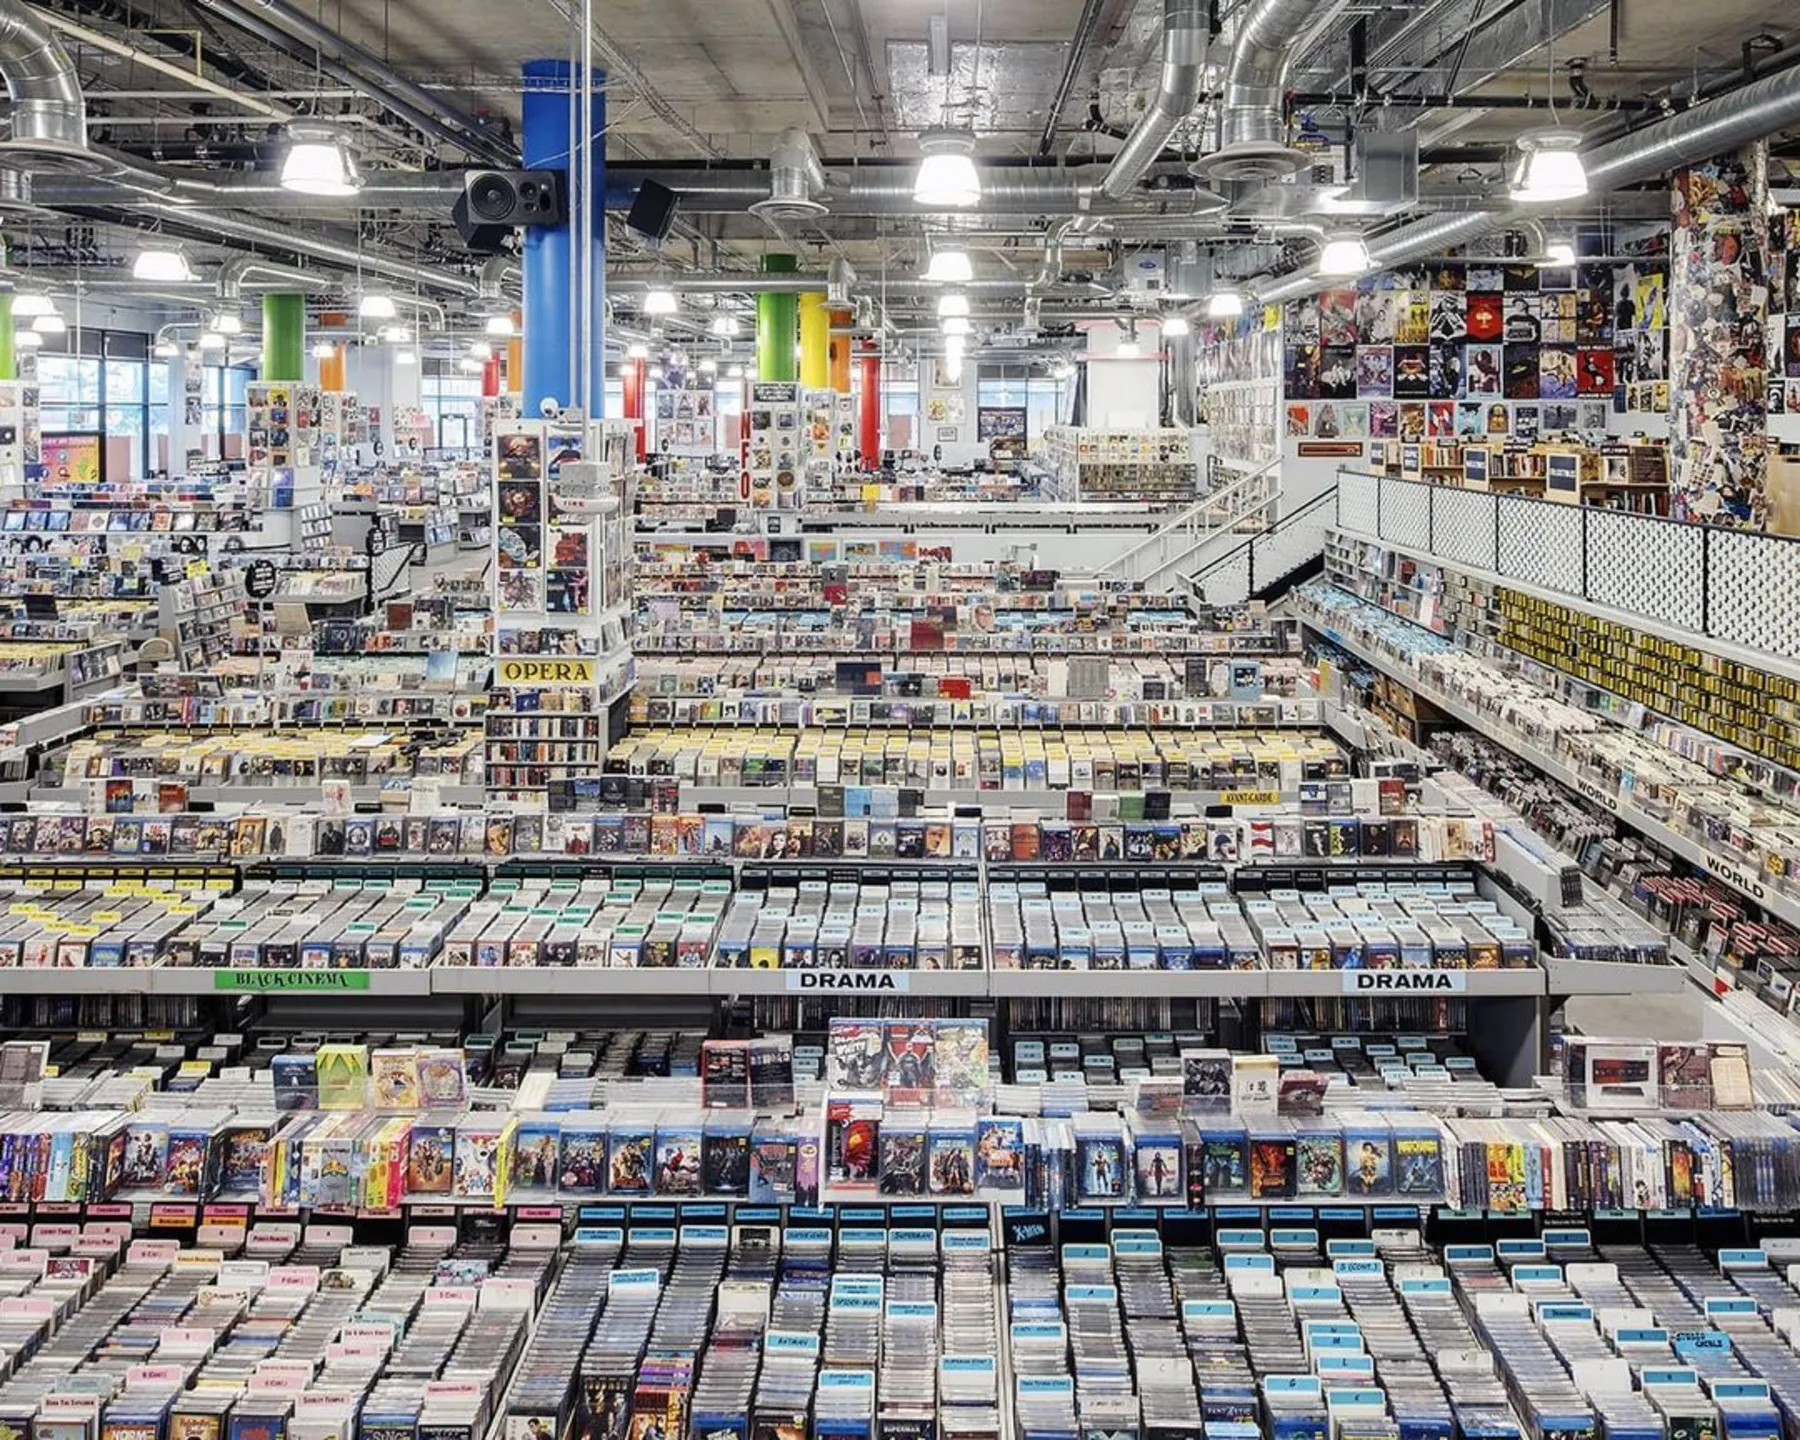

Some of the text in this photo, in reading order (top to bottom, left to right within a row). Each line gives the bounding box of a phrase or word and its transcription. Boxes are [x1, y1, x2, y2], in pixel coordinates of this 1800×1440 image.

[505, 663, 590, 681] OPERA
[1577, 778, 1618, 811] WORLD
[1707, 856, 1765, 900] WORLD
[235, 971, 349, 988] BLACK CINEMA
[800, 973, 895, 989] DRAMA
[1357, 973, 1453, 989] DRAMA
[778, 1336, 809, 1346] BATMAN
